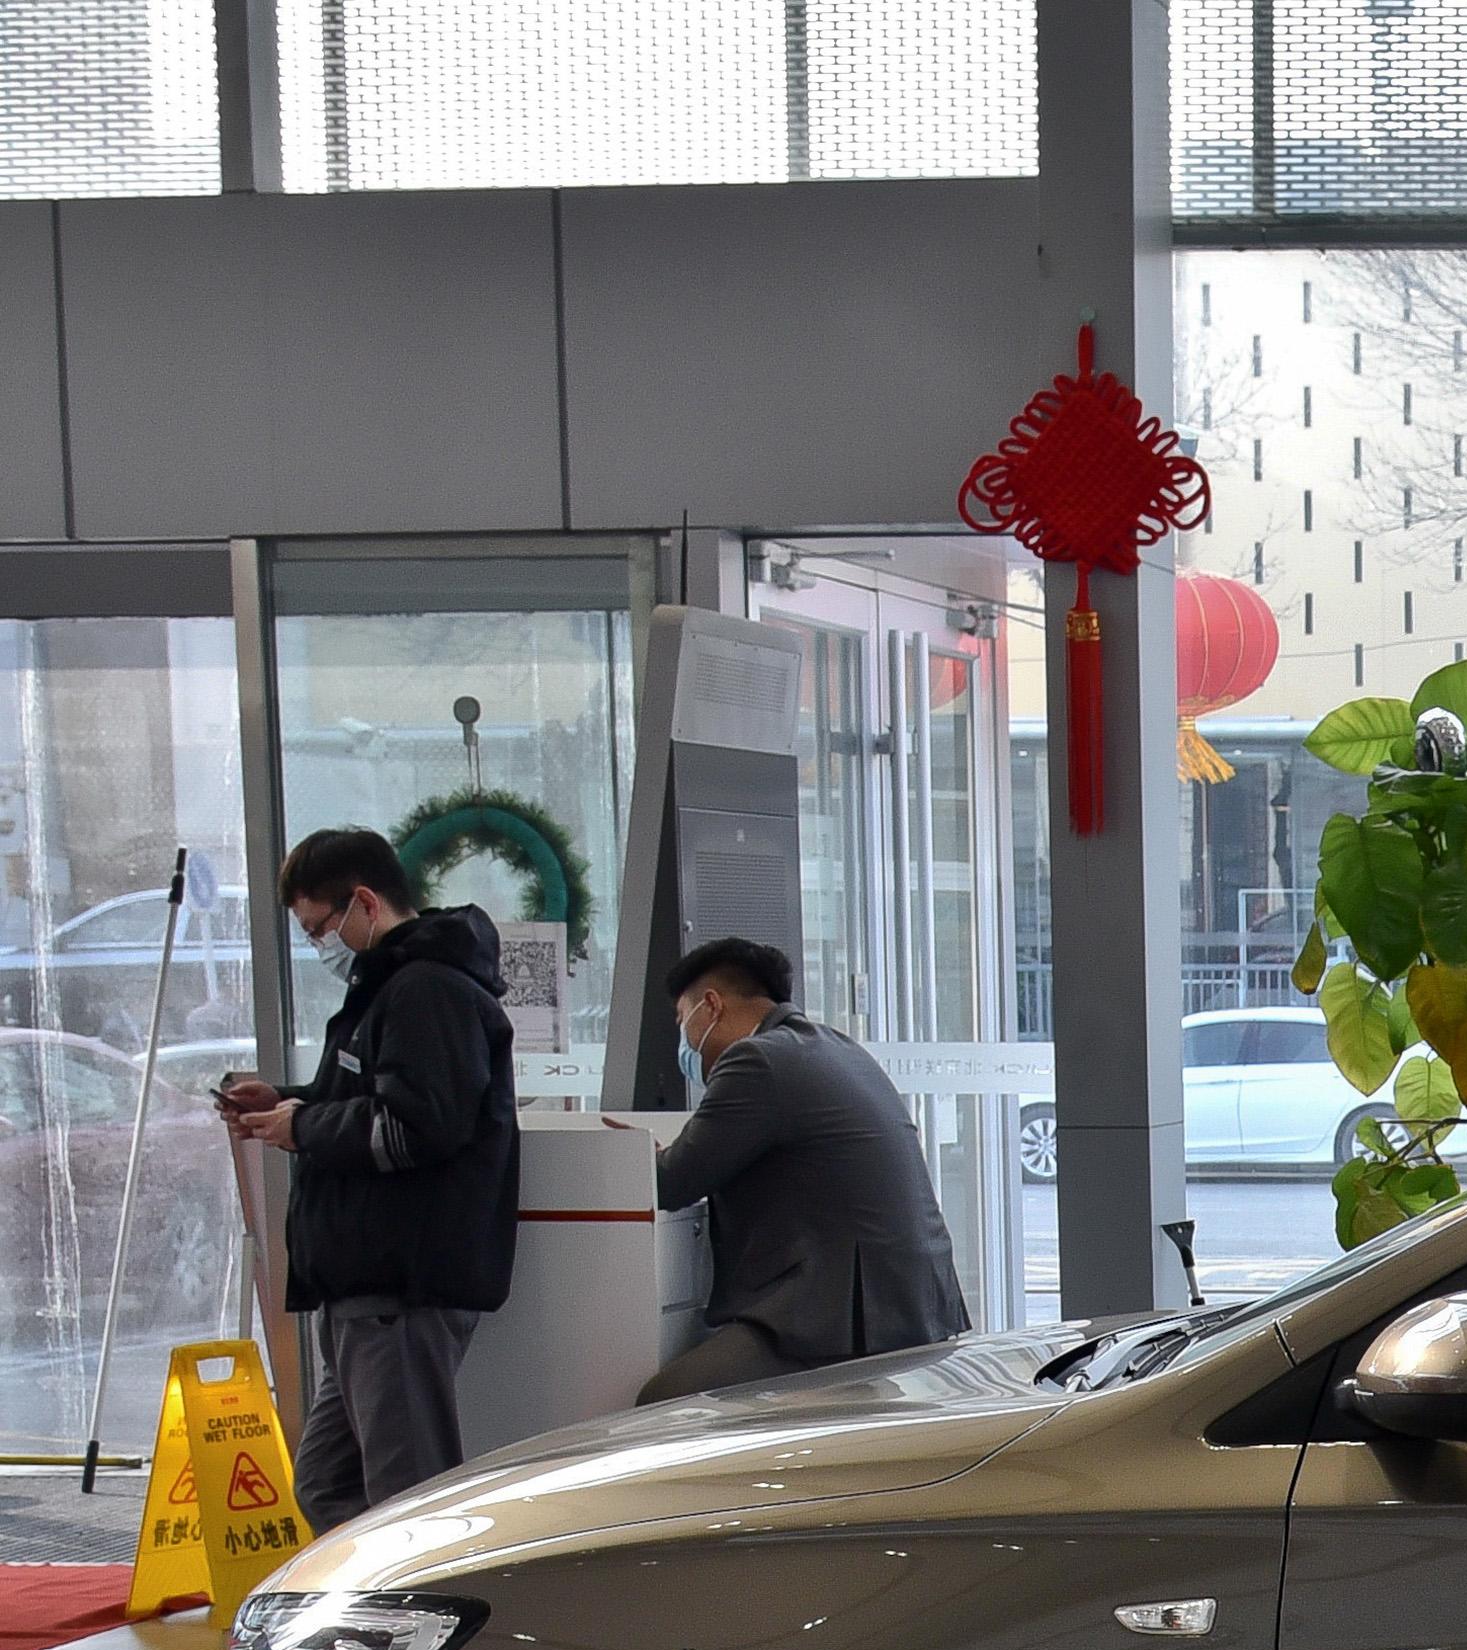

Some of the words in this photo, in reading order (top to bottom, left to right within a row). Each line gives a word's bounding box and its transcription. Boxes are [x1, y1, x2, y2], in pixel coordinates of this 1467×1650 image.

[208, 1413, 261, 1430] CAUTION
[203, 1430, 228, 1443] WET
[232, 1424, 271, 1439] FLOOR
[225, 1516, 300, 1555] 小心地滑
